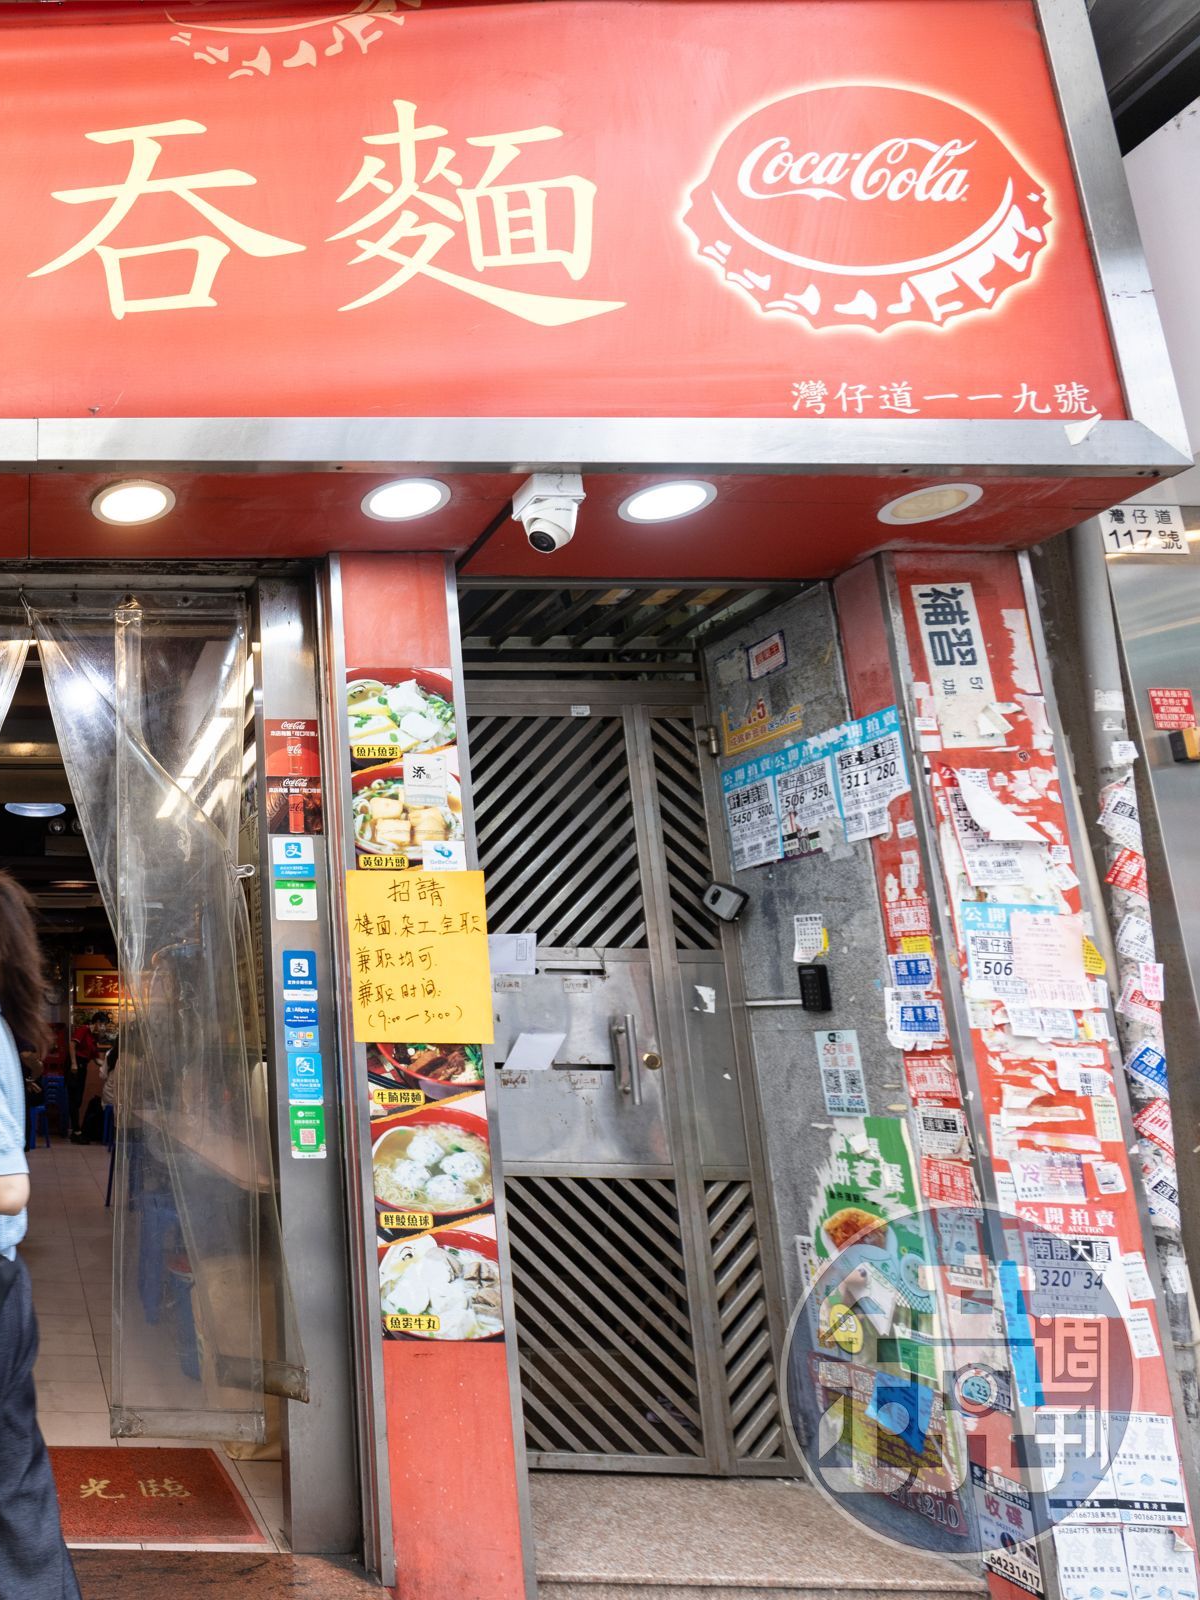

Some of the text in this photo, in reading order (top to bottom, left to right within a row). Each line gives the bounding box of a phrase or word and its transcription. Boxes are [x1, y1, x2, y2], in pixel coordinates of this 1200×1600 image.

[737, 136, 977, 202] Coca-Cola
[791, 380, 1097, 415] 灣仔道一一九號
[1108, 508, 1173, 525] 灣仔道
[1109, 529, 1182, 549] 117號
[918, 587, 978, 667] 補習
[356, 747, 398, 757] 魚片魚蛋
[363, 857, 405, 868] 黃金片頭
[983, 960, 1013, 976] 506
[376, 1091, 422, 1103] 牛腩撈麵
[383, 1214, 430, 1227] 鮮鯪魚球
[1020, 1206, 1116, 1228] 公開拍賣
[390, 1316, 437, 1329] 魚蛋牛丸
[989, 1552, 1041, 1589] 64231417
